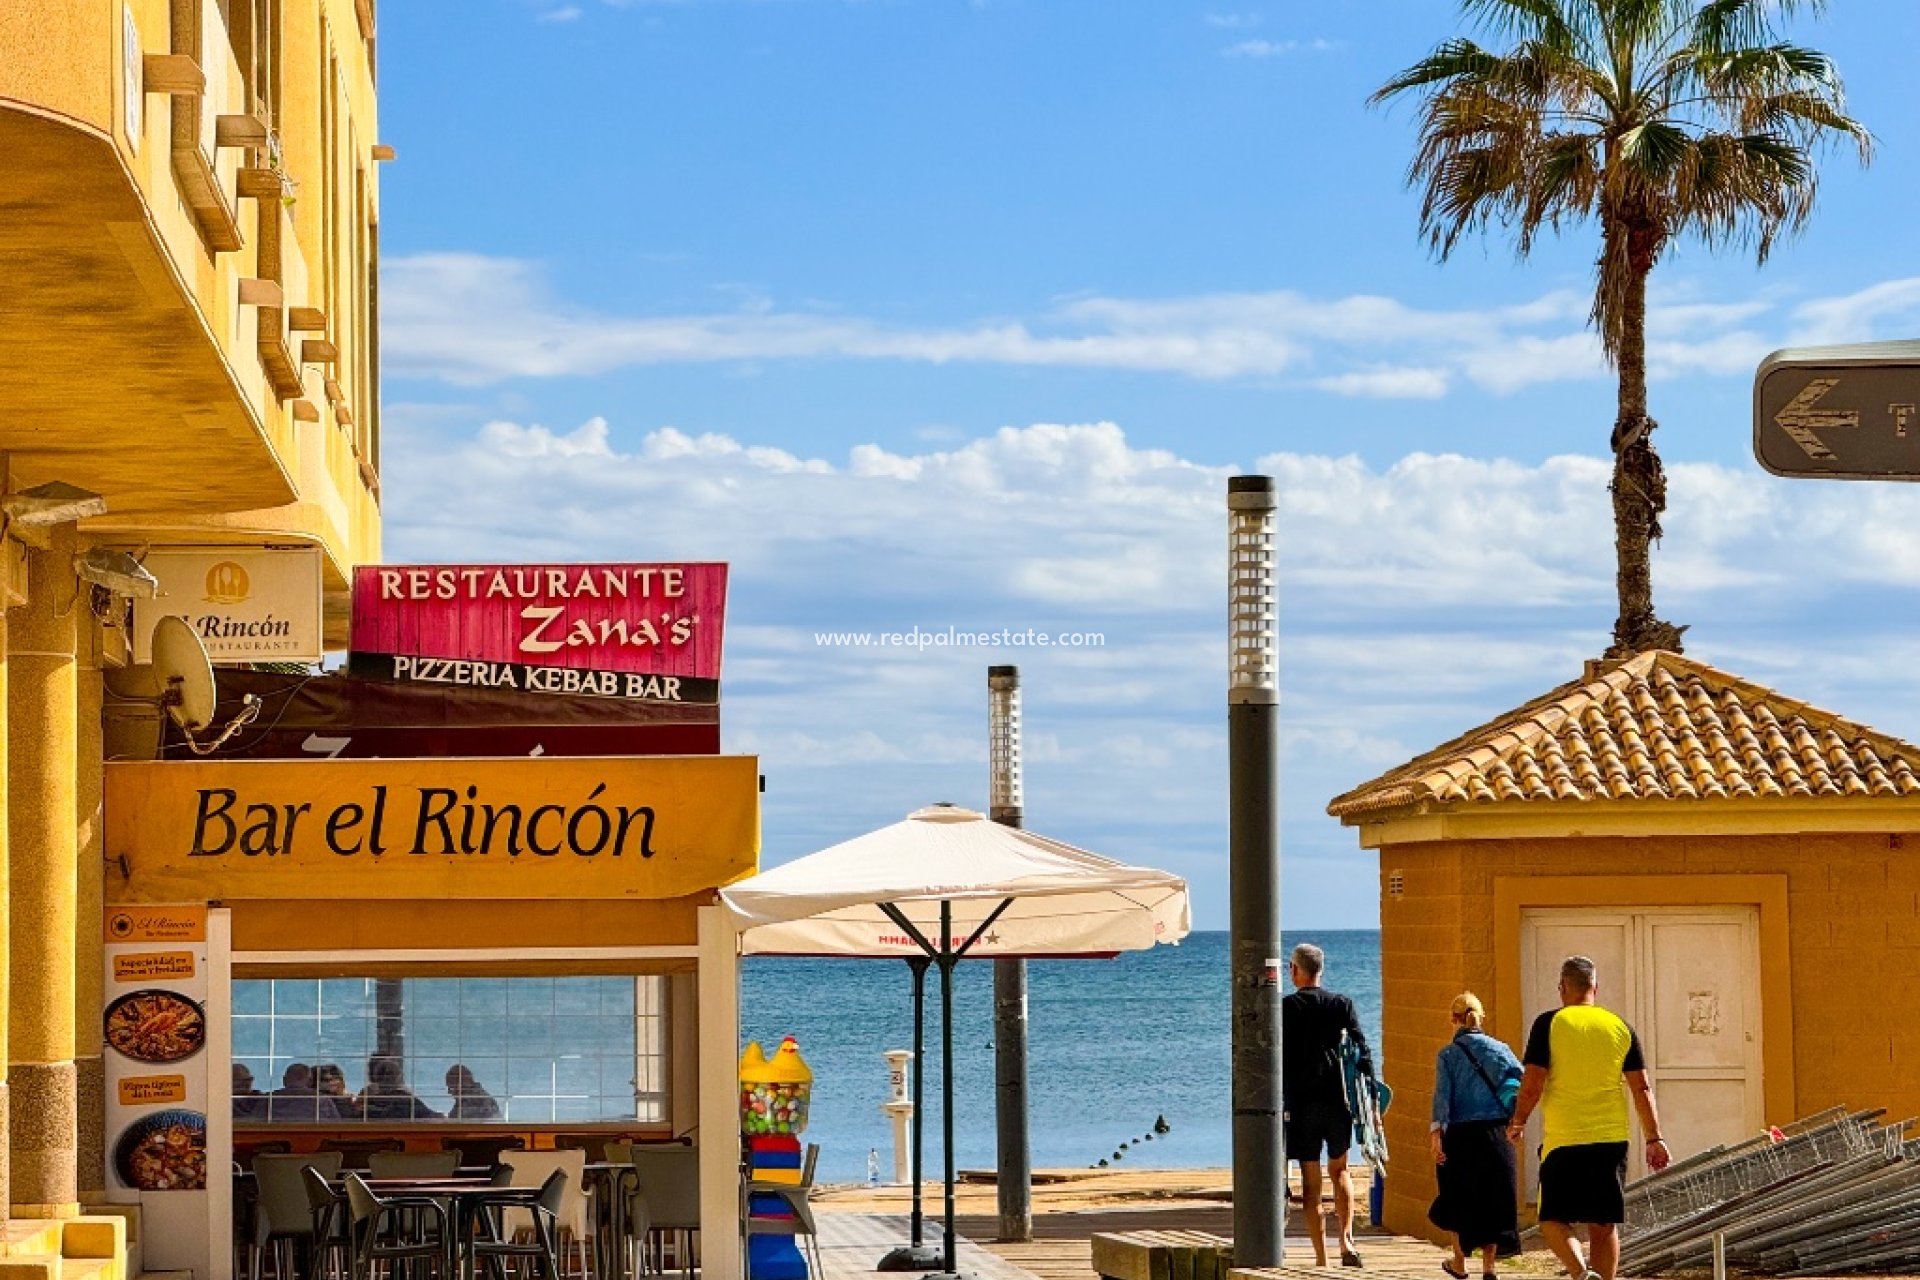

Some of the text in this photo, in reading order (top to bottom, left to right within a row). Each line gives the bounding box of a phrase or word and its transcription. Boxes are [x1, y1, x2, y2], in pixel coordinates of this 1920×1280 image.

[379, 568, 684, 600] RESTAURANTE
[196, 613, 290, 638] Rincón
[204, 641, 299, 651] ESTAURANTE
[393, 656, 681, 700] PIZZERIA KEBAB BAR
[187, 782, 656, 858] Bar el Rincón
